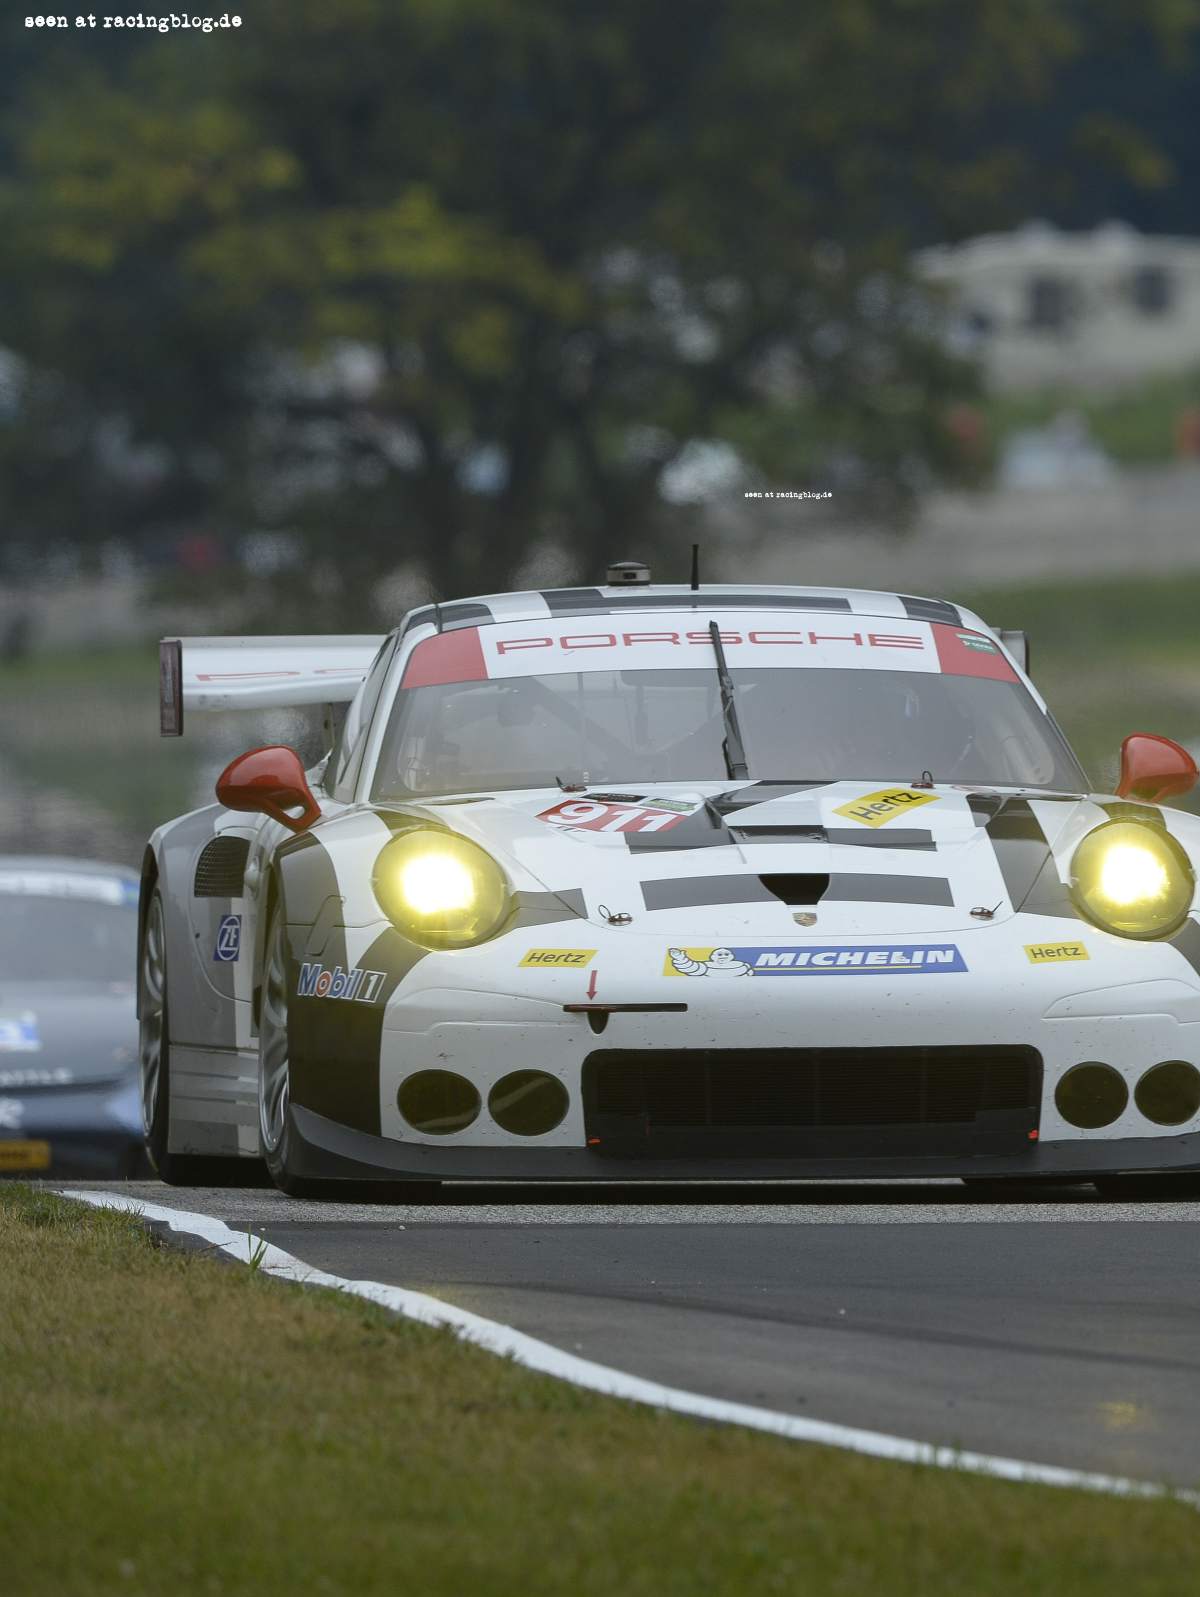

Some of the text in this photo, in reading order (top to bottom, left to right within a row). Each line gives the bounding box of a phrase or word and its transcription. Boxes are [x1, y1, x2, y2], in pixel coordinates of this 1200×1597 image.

[497, 631, 925, 655] PORSCHE
[547, 802, 679, 833] 911
[849, 792, 922, 820] Hertz
[526, 952, 586, 963] Hertz
[754, 950, 954, 967] MICHELIN
[1030, 946, 1081, 960] Hertz
[297, 962, 361, 1000] Mobil
